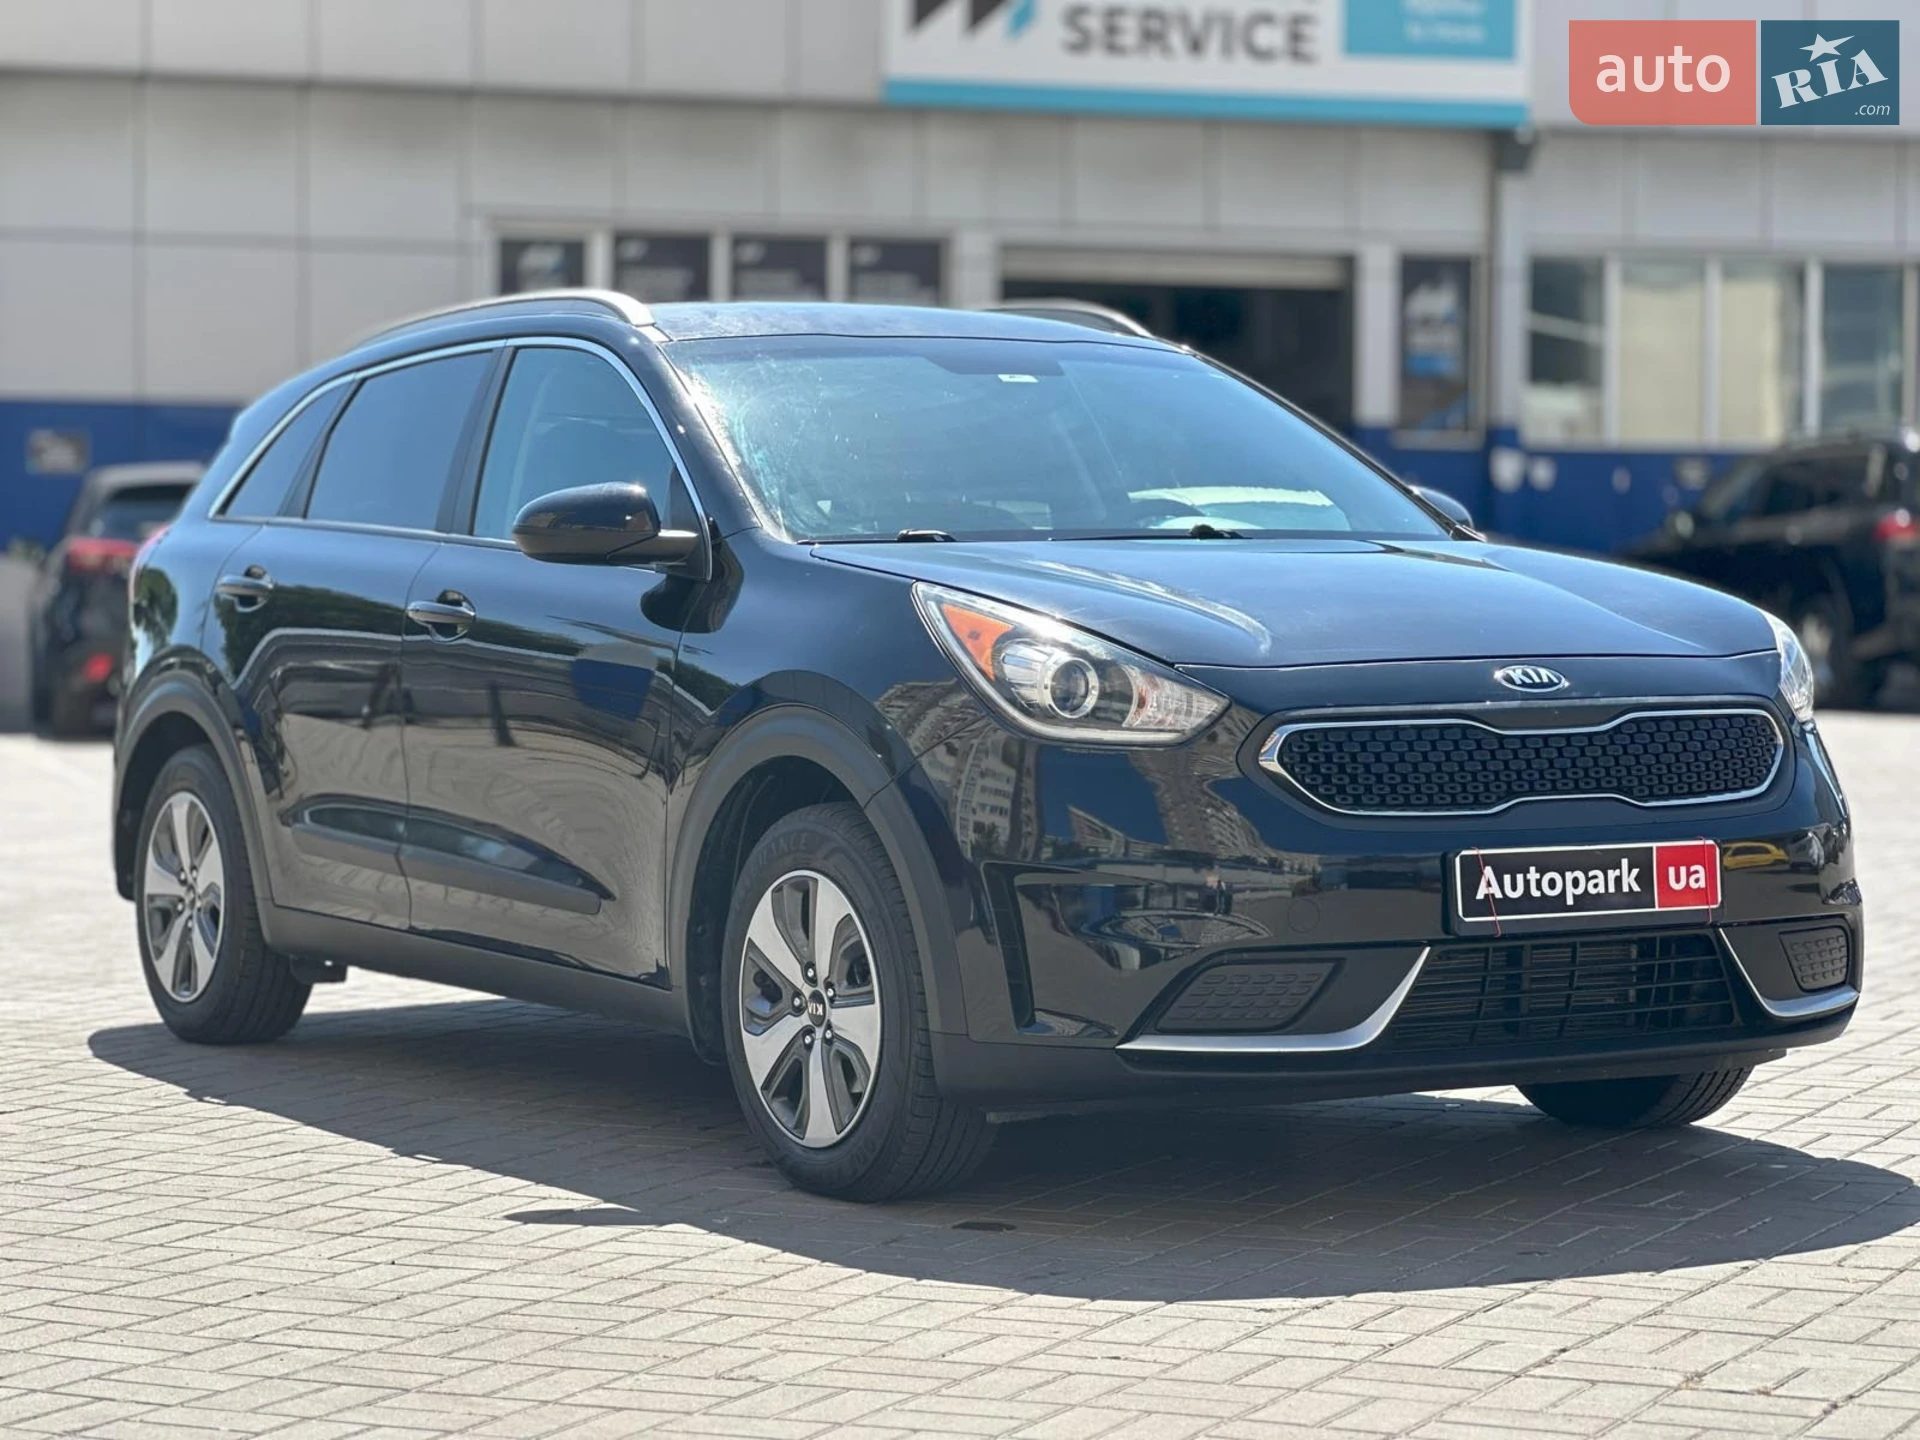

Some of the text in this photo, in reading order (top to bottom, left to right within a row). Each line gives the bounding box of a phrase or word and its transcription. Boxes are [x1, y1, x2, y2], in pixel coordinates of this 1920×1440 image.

[1060, 4, 1320, 64] SERVICE
[1504, 667, 1560, 685] KIA
[1475, 857, 1707, 906] Autopark ua
